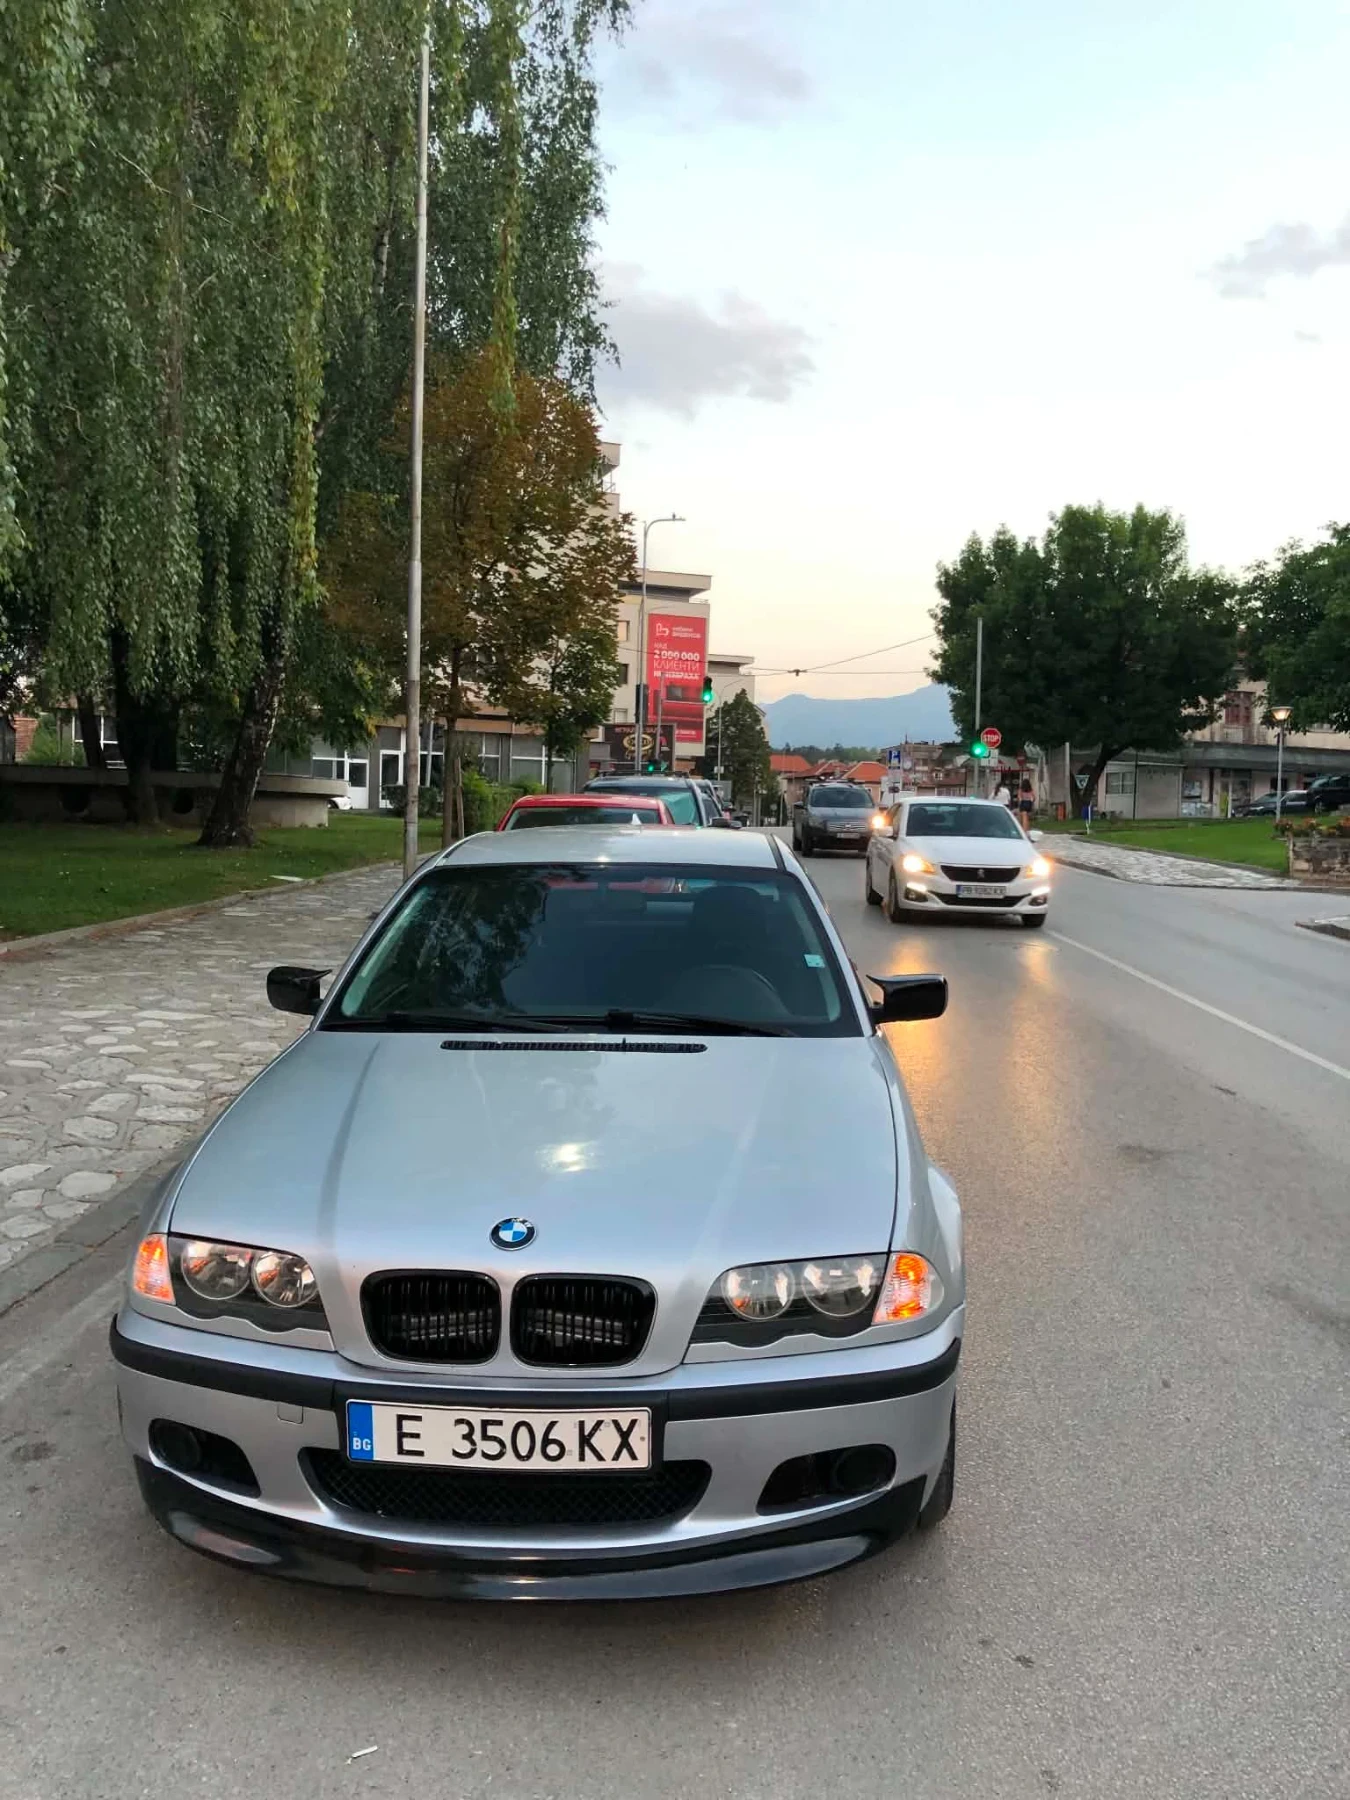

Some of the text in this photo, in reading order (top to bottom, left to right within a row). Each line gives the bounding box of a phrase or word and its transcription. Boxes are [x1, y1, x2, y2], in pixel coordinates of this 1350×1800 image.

[681, 652, 700, 662] 000
[653, 660, 700, 672] КЛИЕНТИ
[982, 734, 1000, 743] STOP
[396, 1413, 640, 1462] E 3506 KX
[352, 1437, 372, 1451] BG
